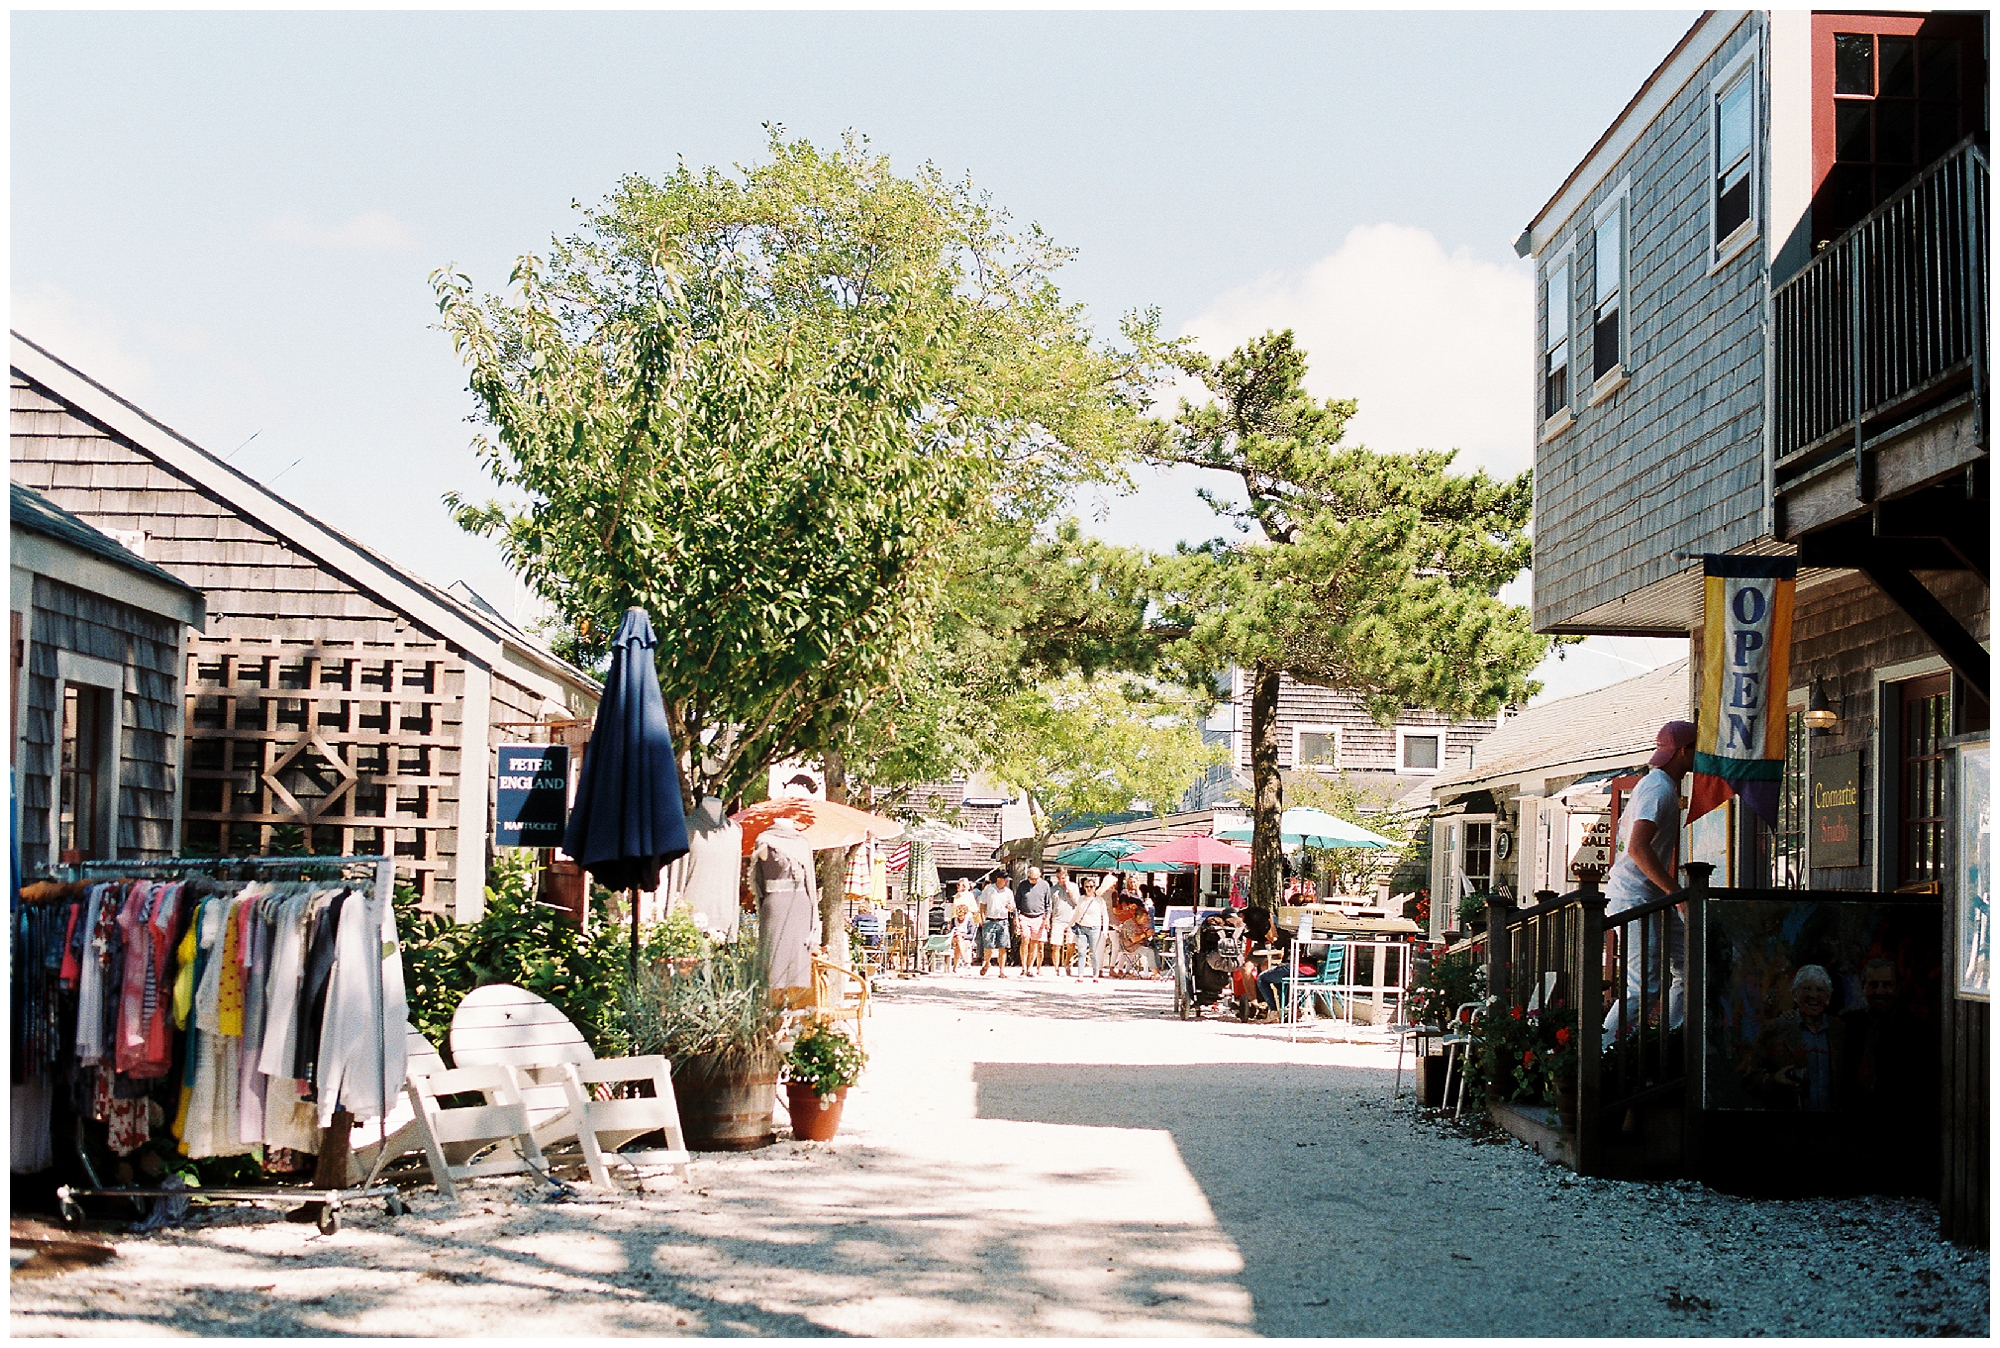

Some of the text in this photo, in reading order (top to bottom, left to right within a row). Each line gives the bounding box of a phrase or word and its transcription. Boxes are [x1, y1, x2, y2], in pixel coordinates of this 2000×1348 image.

[1727, 586, 1766, 750] OPEN
[509, 758, 553, 771] PETER
[499, 776, 565, 790] ENGLAND
[1815, 780, 1857, 809] Cromartie
[503, 821, 558, 831] NANTUCKET
[1821, 814, 1849, 843] Studio
[1595, 849, 1606, 861] &
